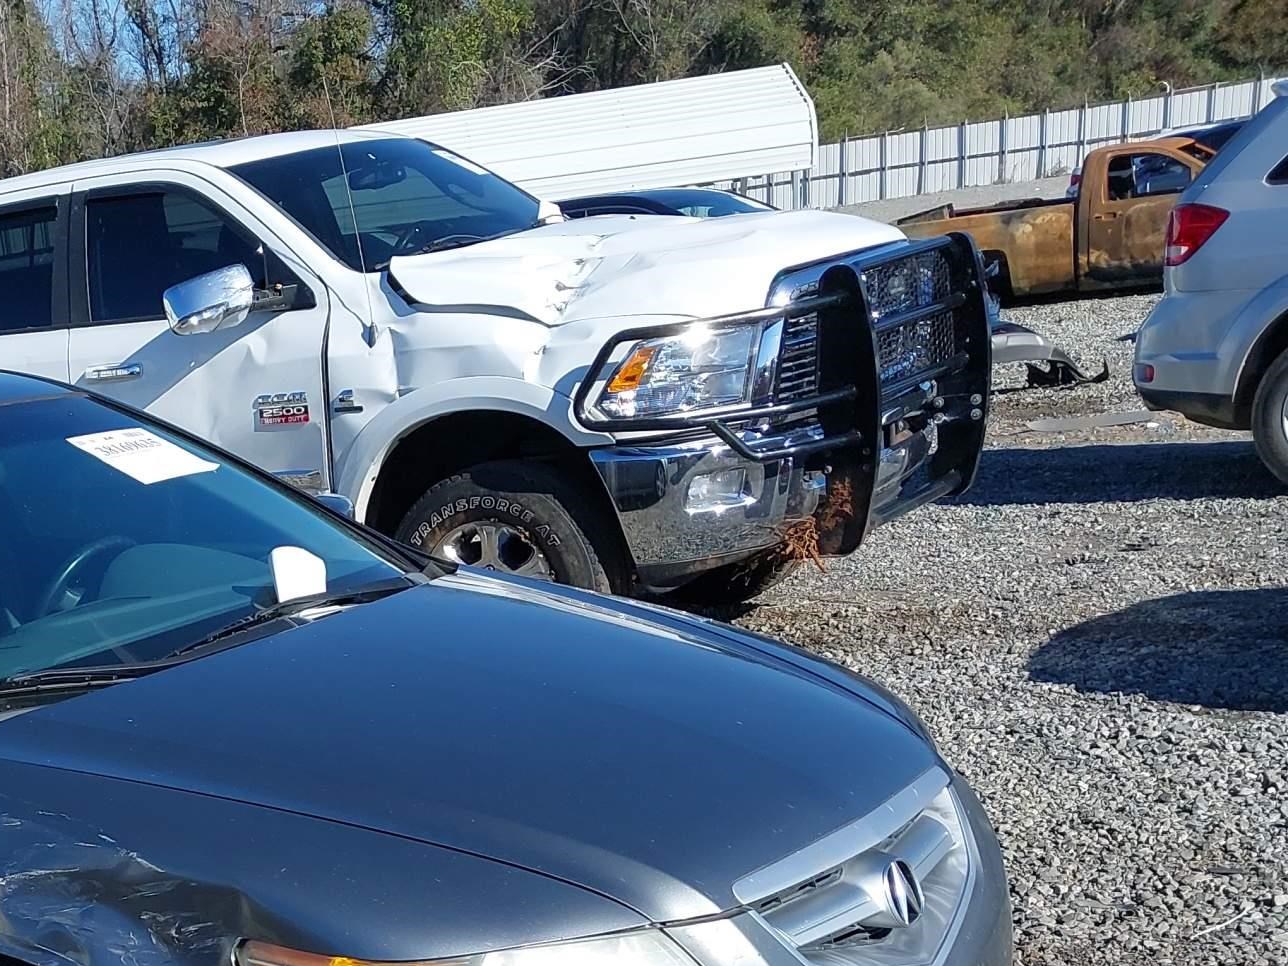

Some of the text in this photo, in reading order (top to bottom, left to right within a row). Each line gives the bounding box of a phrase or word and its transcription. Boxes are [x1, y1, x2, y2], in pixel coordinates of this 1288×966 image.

[262, 406, 305, 417] 2500
[410, 496, 561, 547] TRANSFORCE AT
